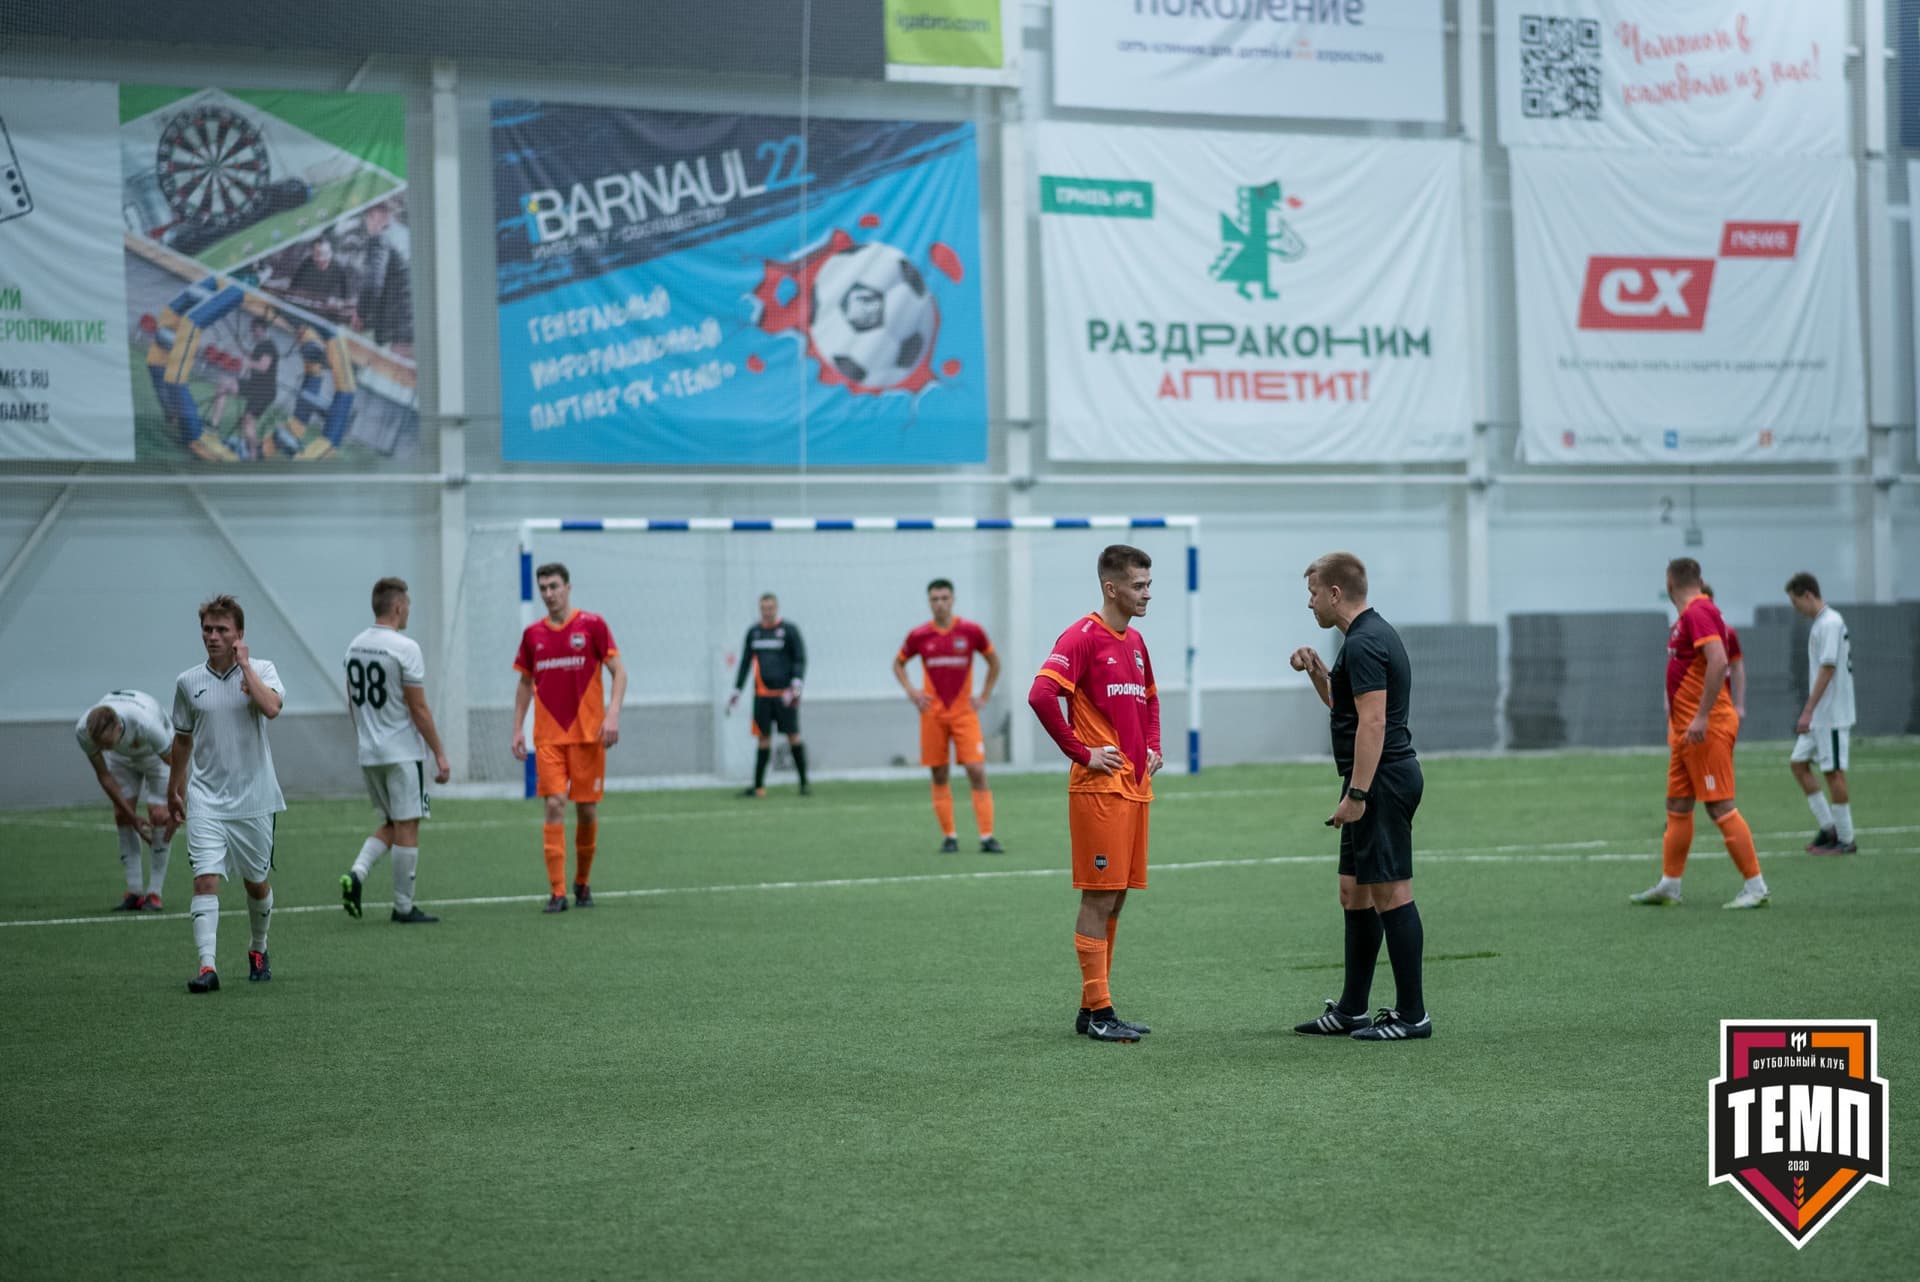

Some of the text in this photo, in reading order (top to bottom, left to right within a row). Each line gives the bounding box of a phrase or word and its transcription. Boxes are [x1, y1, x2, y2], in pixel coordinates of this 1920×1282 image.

[1730, 230, 1788, 250] news
[1087, 319, 1431, 362] РАЗДРАКОНИМ
[1157, 370, 1371, 402] АППЕТИТ!
[347, 657, 388, 710] 98
